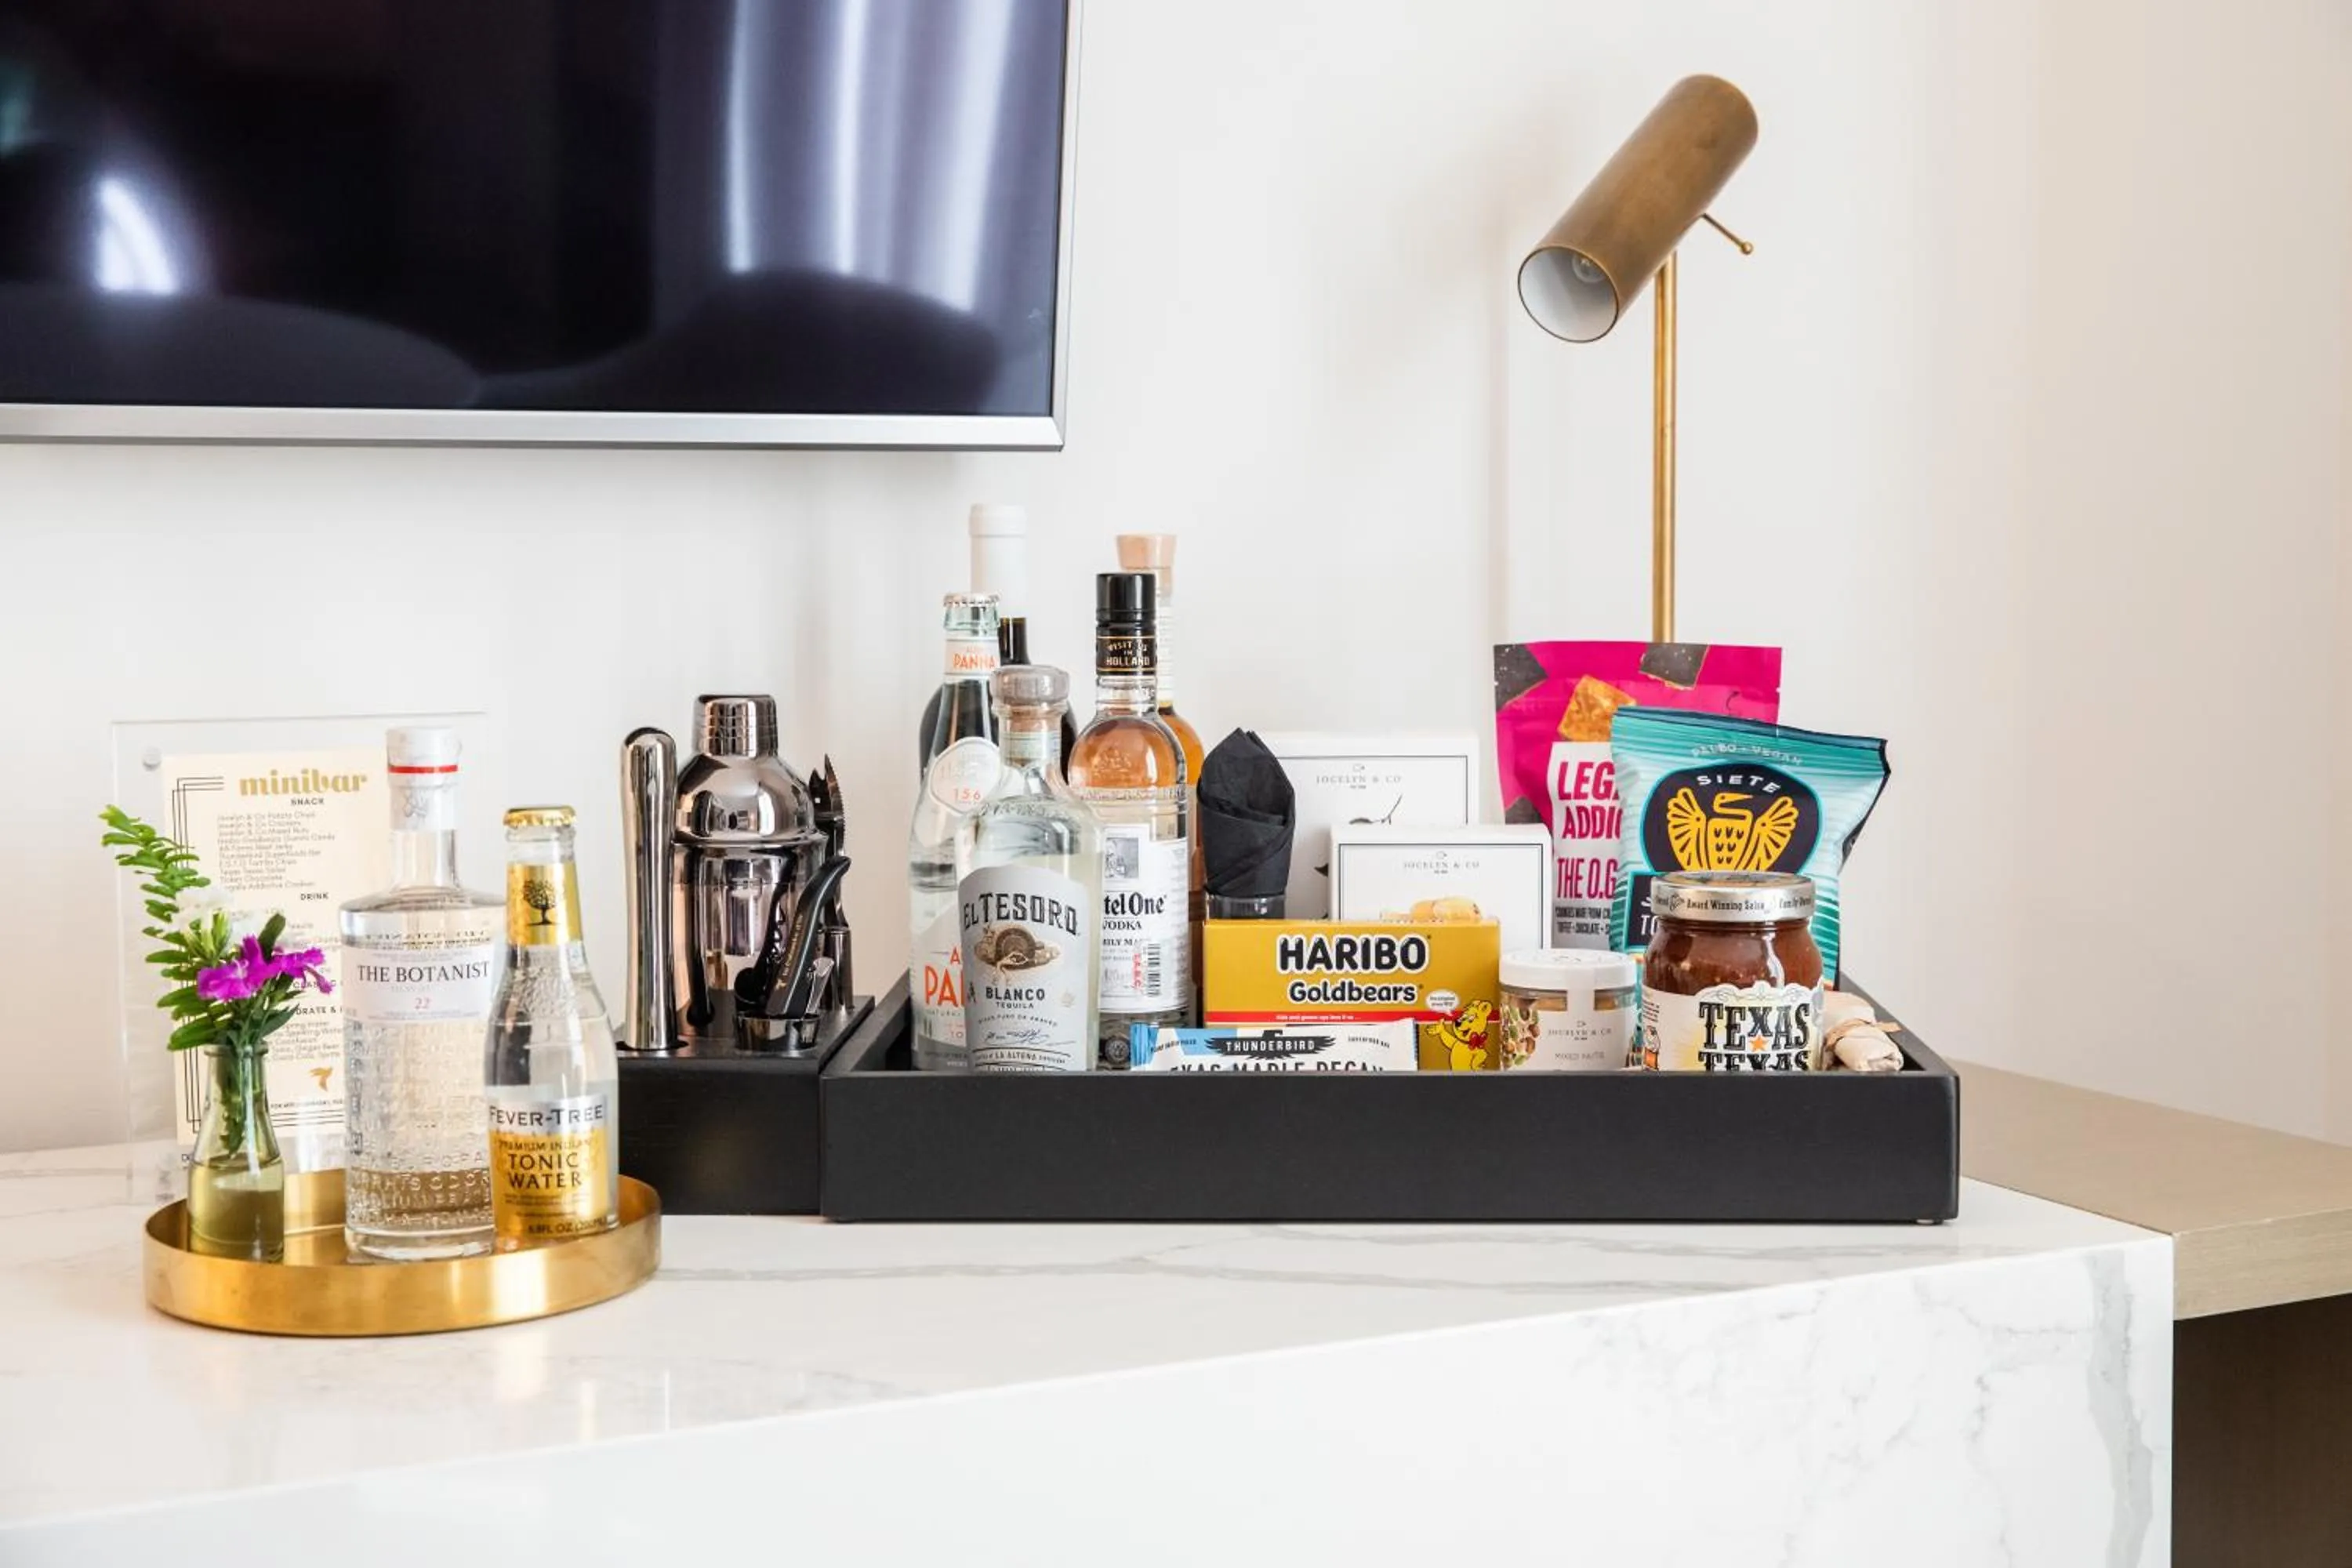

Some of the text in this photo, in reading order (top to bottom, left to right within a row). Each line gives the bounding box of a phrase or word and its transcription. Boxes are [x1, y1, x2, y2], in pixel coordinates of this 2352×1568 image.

[1106, 656, 1150, 666] HOLLAND
[239, 768, 367, 796] minibar
[1558, 760, 1619, 800] LEG
[1697, 774, 1781, 793] SIETE
[291, 797, 325, 806] SNACK
[953, 788, 982, 801] 156
[1557, 858, 1584, 899] THE
[300, 892, 329, 901] DRINK
[1104, 891, 1165, 916] tel One
[1711, 900, 1743, 912] Winning
[964, 893, 1077, 935] EL TESORO
[1279, 936, 1427, 971] HARIBO
[357, 960, 490, 982] THE BOTANIST
[985, 987, 1046, 1001] BLANCO
[1290, 980, 1416, 1003] Goldbears
[296, 1006, 326, 1015] DRATE
[415, 997, 431, 1010] 22
[1698, 1001, 1811, 1051] TEXAS
[1226, 1040, 1316, 1051] THUNDERBIRD
[489, 1105, 604, 1127] FEVER-TREE
[508, 1152, 579, 1171] TONIC
[508, 1171, 583, 1189] WATER
